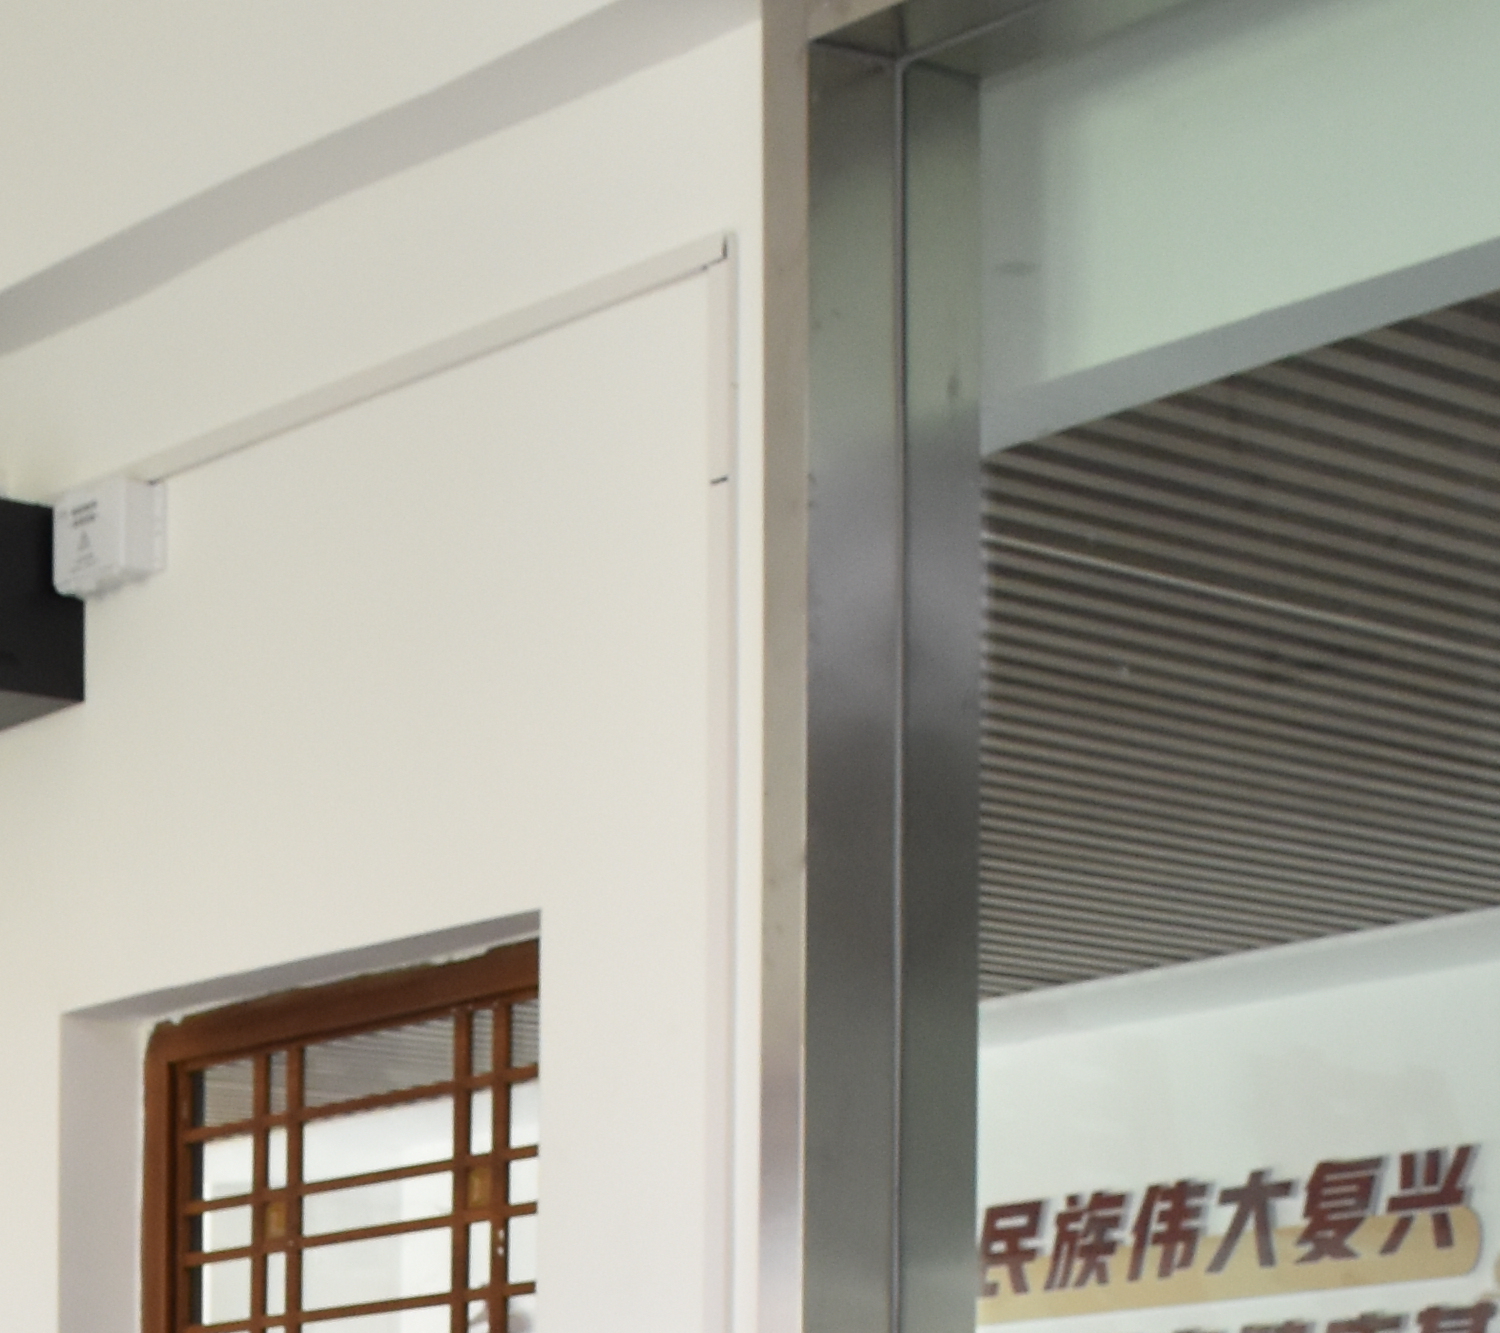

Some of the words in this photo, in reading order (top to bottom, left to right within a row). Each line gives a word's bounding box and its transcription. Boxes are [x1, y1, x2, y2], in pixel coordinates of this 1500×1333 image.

[980, 1144, 1480, 1297] 民族伟大复兴
